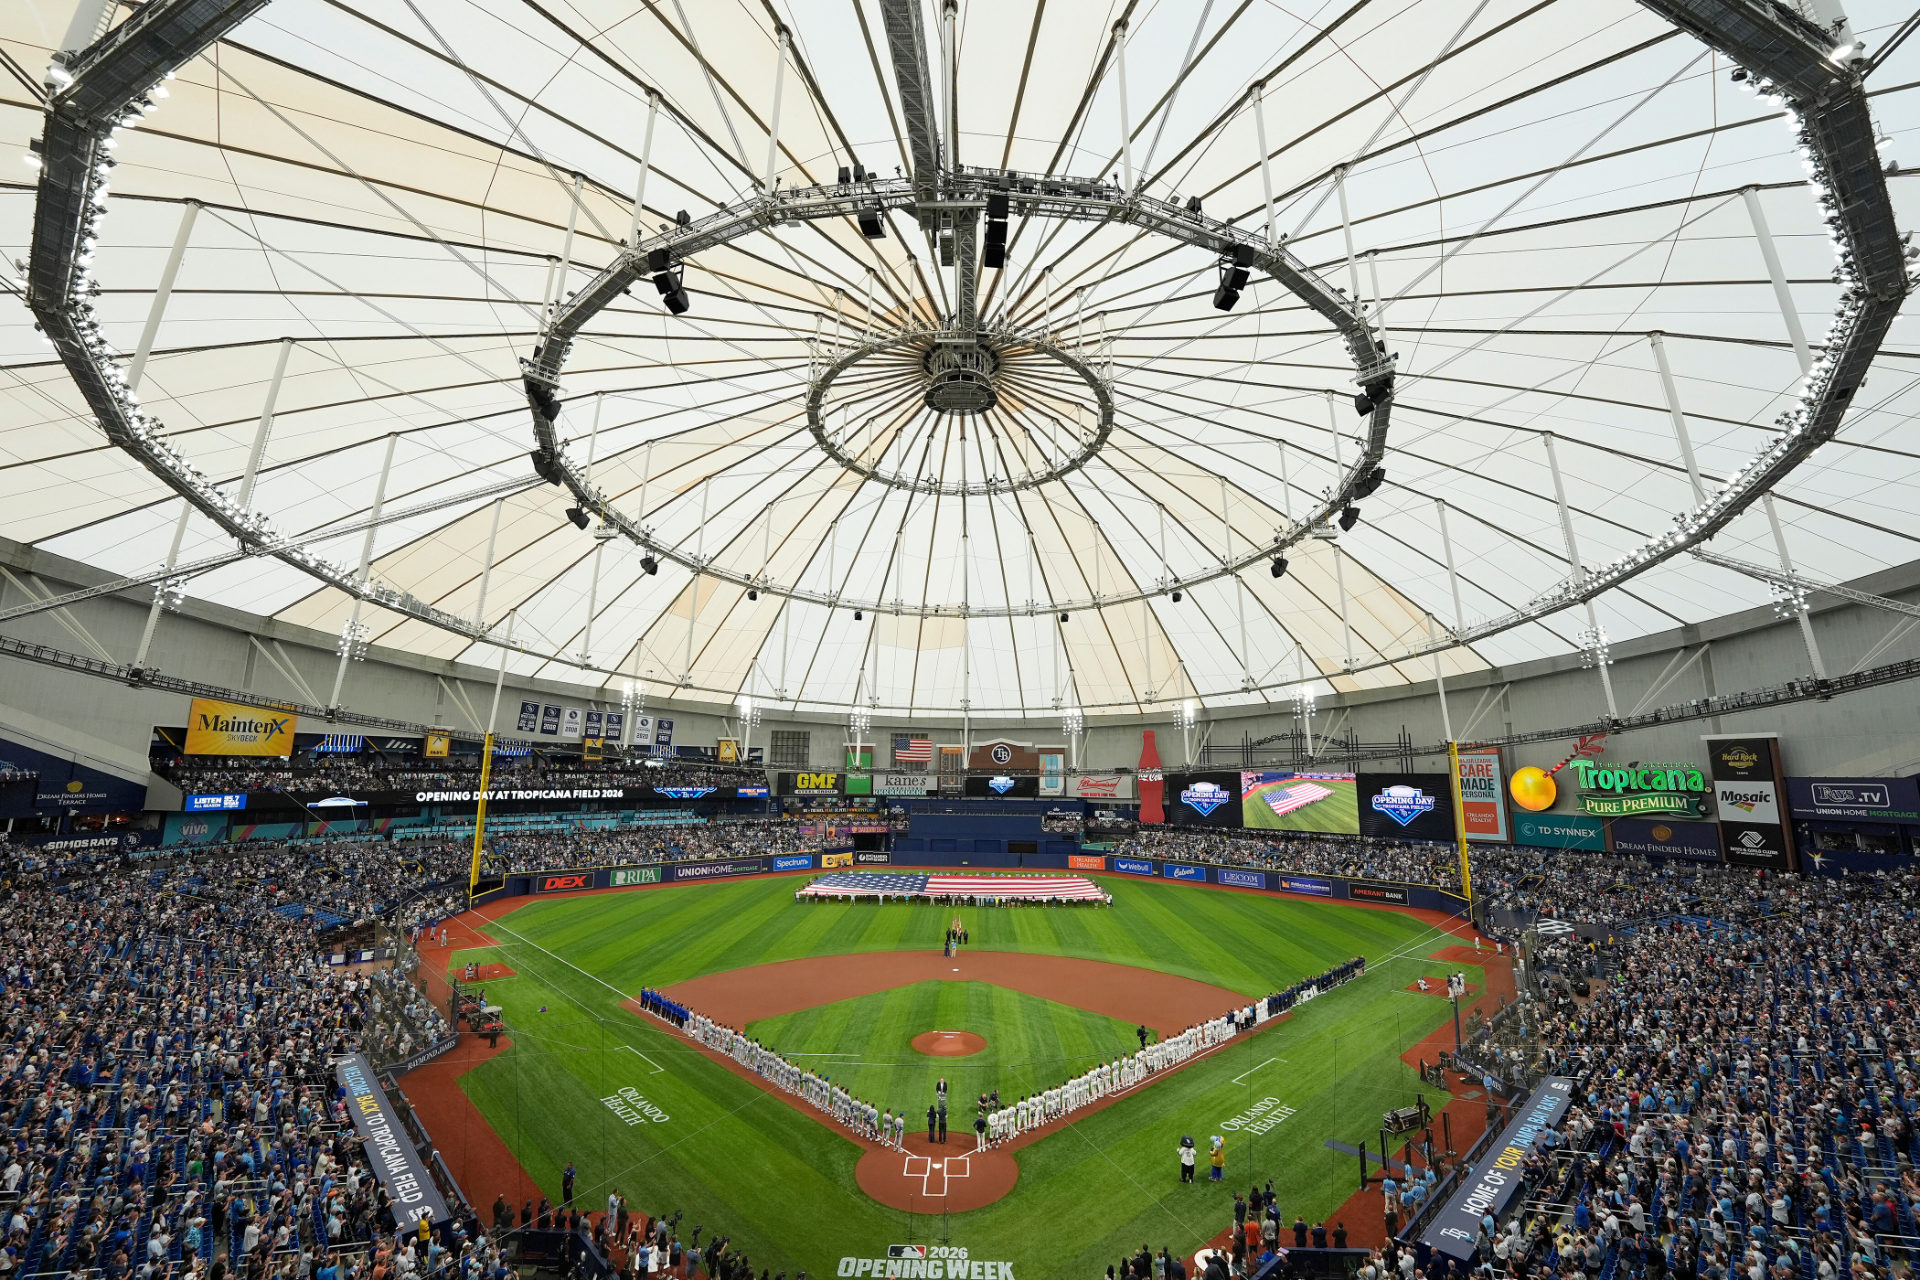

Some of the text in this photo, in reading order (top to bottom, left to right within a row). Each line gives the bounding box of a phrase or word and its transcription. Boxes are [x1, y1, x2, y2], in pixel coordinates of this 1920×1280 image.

[198, 714, 288, 741] MaintenX
[1741, 753, 1757, 761] Rock
[1459, 764, 1493, 777] CARE
[1570, 760, 1704, 794] Tropicana
[797, 773, 836, 788] GMF
[885, 775, 926, 786] kane's
[1460, 778, 1495, 790] MADE
[416, 789, 623, 801] OPENING DAY AT TROPICANA FIELD 2026
[1374, 796, 1432, 805] OPENING DAY
[1721, 791, 1770, 802] Mosaic
[1586, 796, 1688, 812] PURE PREMIUM
[1869, 810, 1918, 818] MORTGAGE
[182, 824, 208, 835] VIVA
[1538, 826, 1596, 837] TD SYNNEX
[48, 837, 118, 850] SOMOS RAYS
[1616, 841, 1717, 856] DREAM FINDERS HOMES
[777, 857, 806, 868] Spectrum
[1128, 863, 1148, 871] Webull
[544, 875, 588, 890] DEX
[626, 869, 656, 883] RIPA
[1224, 873, 1258, 883] LECOM
[440, 888, 454, 898] 162
[1354, 889, 1384, 897] AMERANT
[408, 1041, 456, 1070] RAYMOND JAMES
[343, 1066, 371, 1096] WELCOME
[356, 1095, 380, 1115] BACK
[600, 1095, 645, 1126] HEALTH
[618, 1086, 670, 1122] ORLANDO
[1539, 1095, 1561, 1113] RAYS
[365, 1112, 386, 1126] TO
[1220, 1097, 1280, 1131] ORLANDO
[1244, 1104, 1297, 1135] HEALTH
[1528, 1108, 1550, 1126] BAY
[1510, 1122, 1539, 1150] TAMPA
[370, 1124, 409, 1175] TROPICANA
[1493, 1146, 1525, 1171] YOUR
[1484, 1170, 1507, 1186] OF
[392, 1173, 423, 1203] FIELD
[1461, 1183, 1500, 1217] HOME
[929, 1246, 968, 1259] 2026
[837, 1257, 1014, 1280] OPENING WEEK
